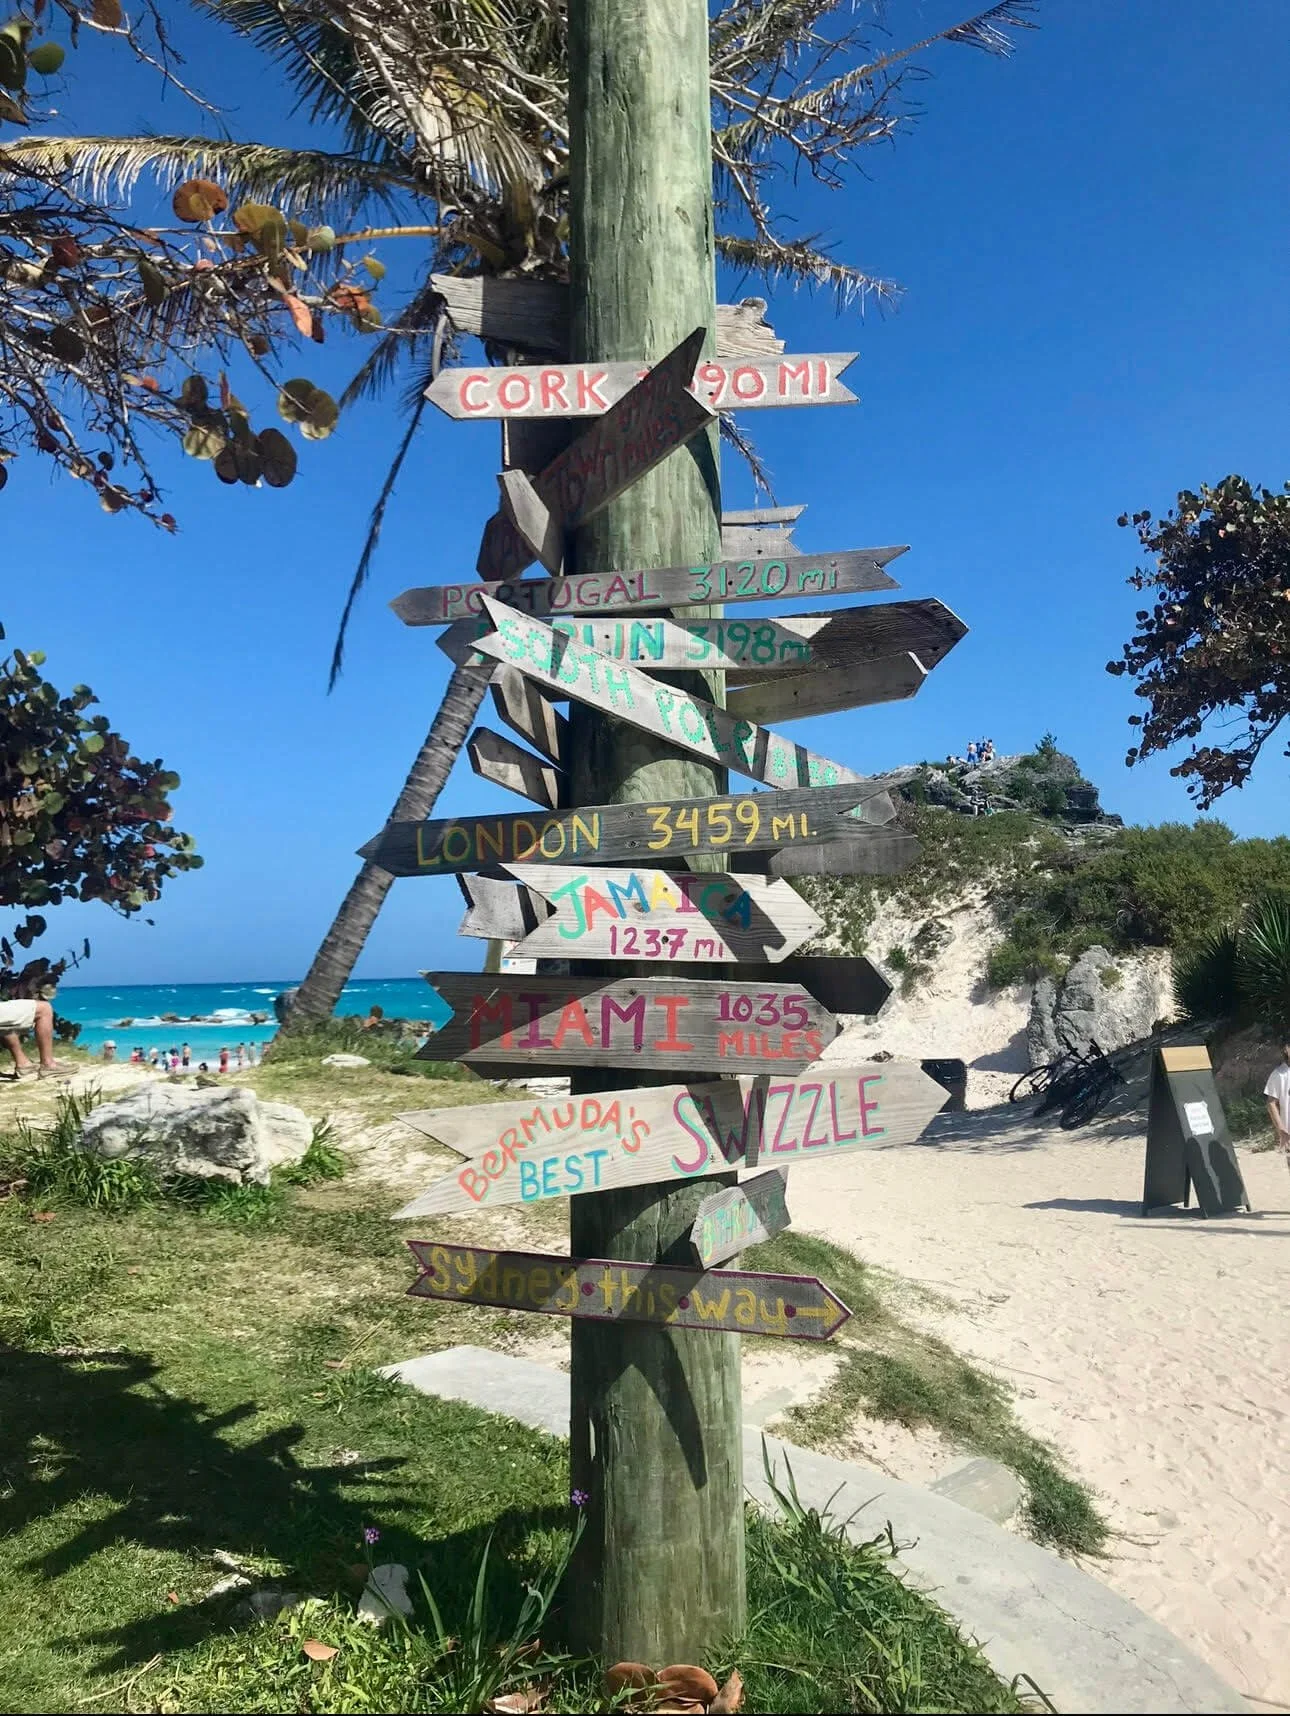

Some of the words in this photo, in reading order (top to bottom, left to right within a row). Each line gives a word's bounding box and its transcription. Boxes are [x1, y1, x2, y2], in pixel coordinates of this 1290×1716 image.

[459, 371, 609, 412] CORK
[777, 360, 832, 398] MI
[442, 571, 660, 618] PORTUGAL
[688, 560, 788, 600] 3120
[797, 561, 839, 592] mi
[498, 619, 635, 706] SOUTH
[685, 622, 777, 665] 3198
[416, 813, 604, 866] LONDON
[647, 800, 760, 850] 3459
[772, 813, 817, 841] MI.
[550, 871, 751, 940] JAMAICA
[610, 925, 688, 959] 1237
[470, 993, 696, 1053] MIAMI
[713, 992, 809, 1031] 1035
[717, 1030, 825, 1062] MILES
[671, 1075, 886, 1177] SWIZZLE
[520, 1149, 609, 1204] BEST
[426, 1246, 580, 1312] Sydney
[597, 1269, 679, 1324] this
[690, 1286, 786, 1335] way
